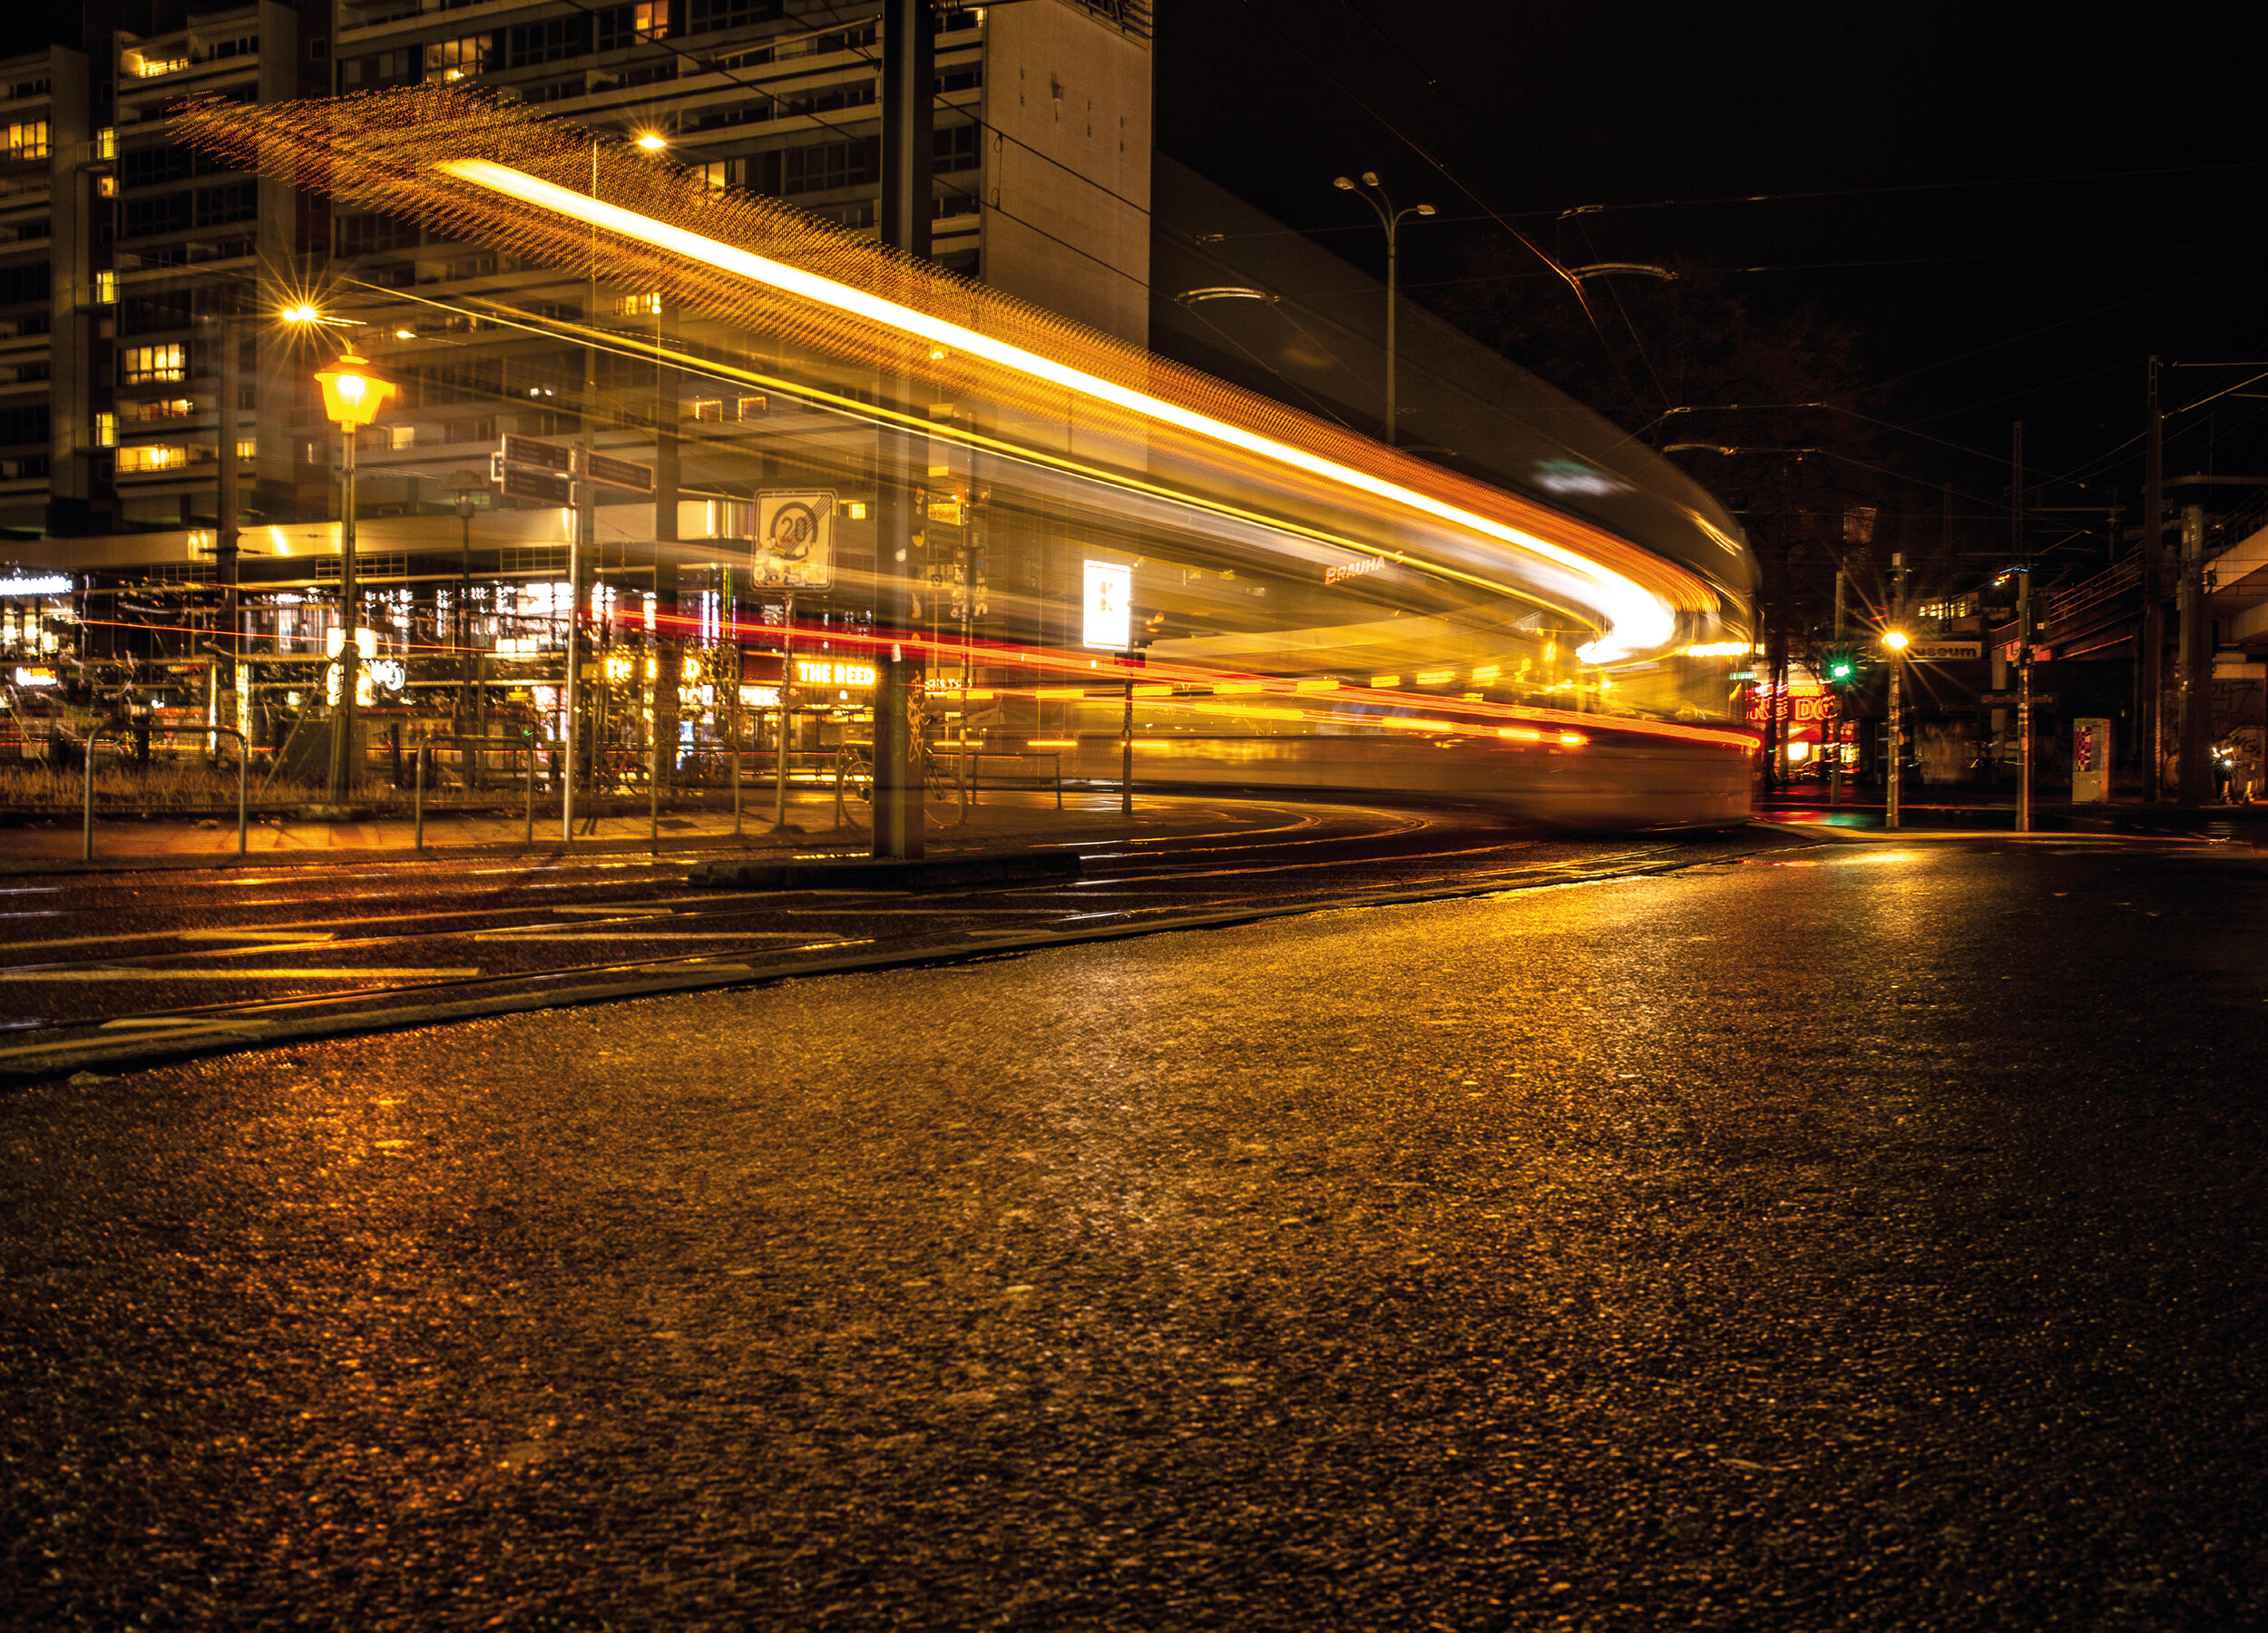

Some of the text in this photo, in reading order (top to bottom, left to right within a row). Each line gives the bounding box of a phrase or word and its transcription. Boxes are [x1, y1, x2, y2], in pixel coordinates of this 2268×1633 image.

[781, 516, 807, 543] 20
[1325, 550, 1403, 585] BRAUHAS
[1911, 645, 1977, 659] useum
[798, 662, 875, 685] THE REED
